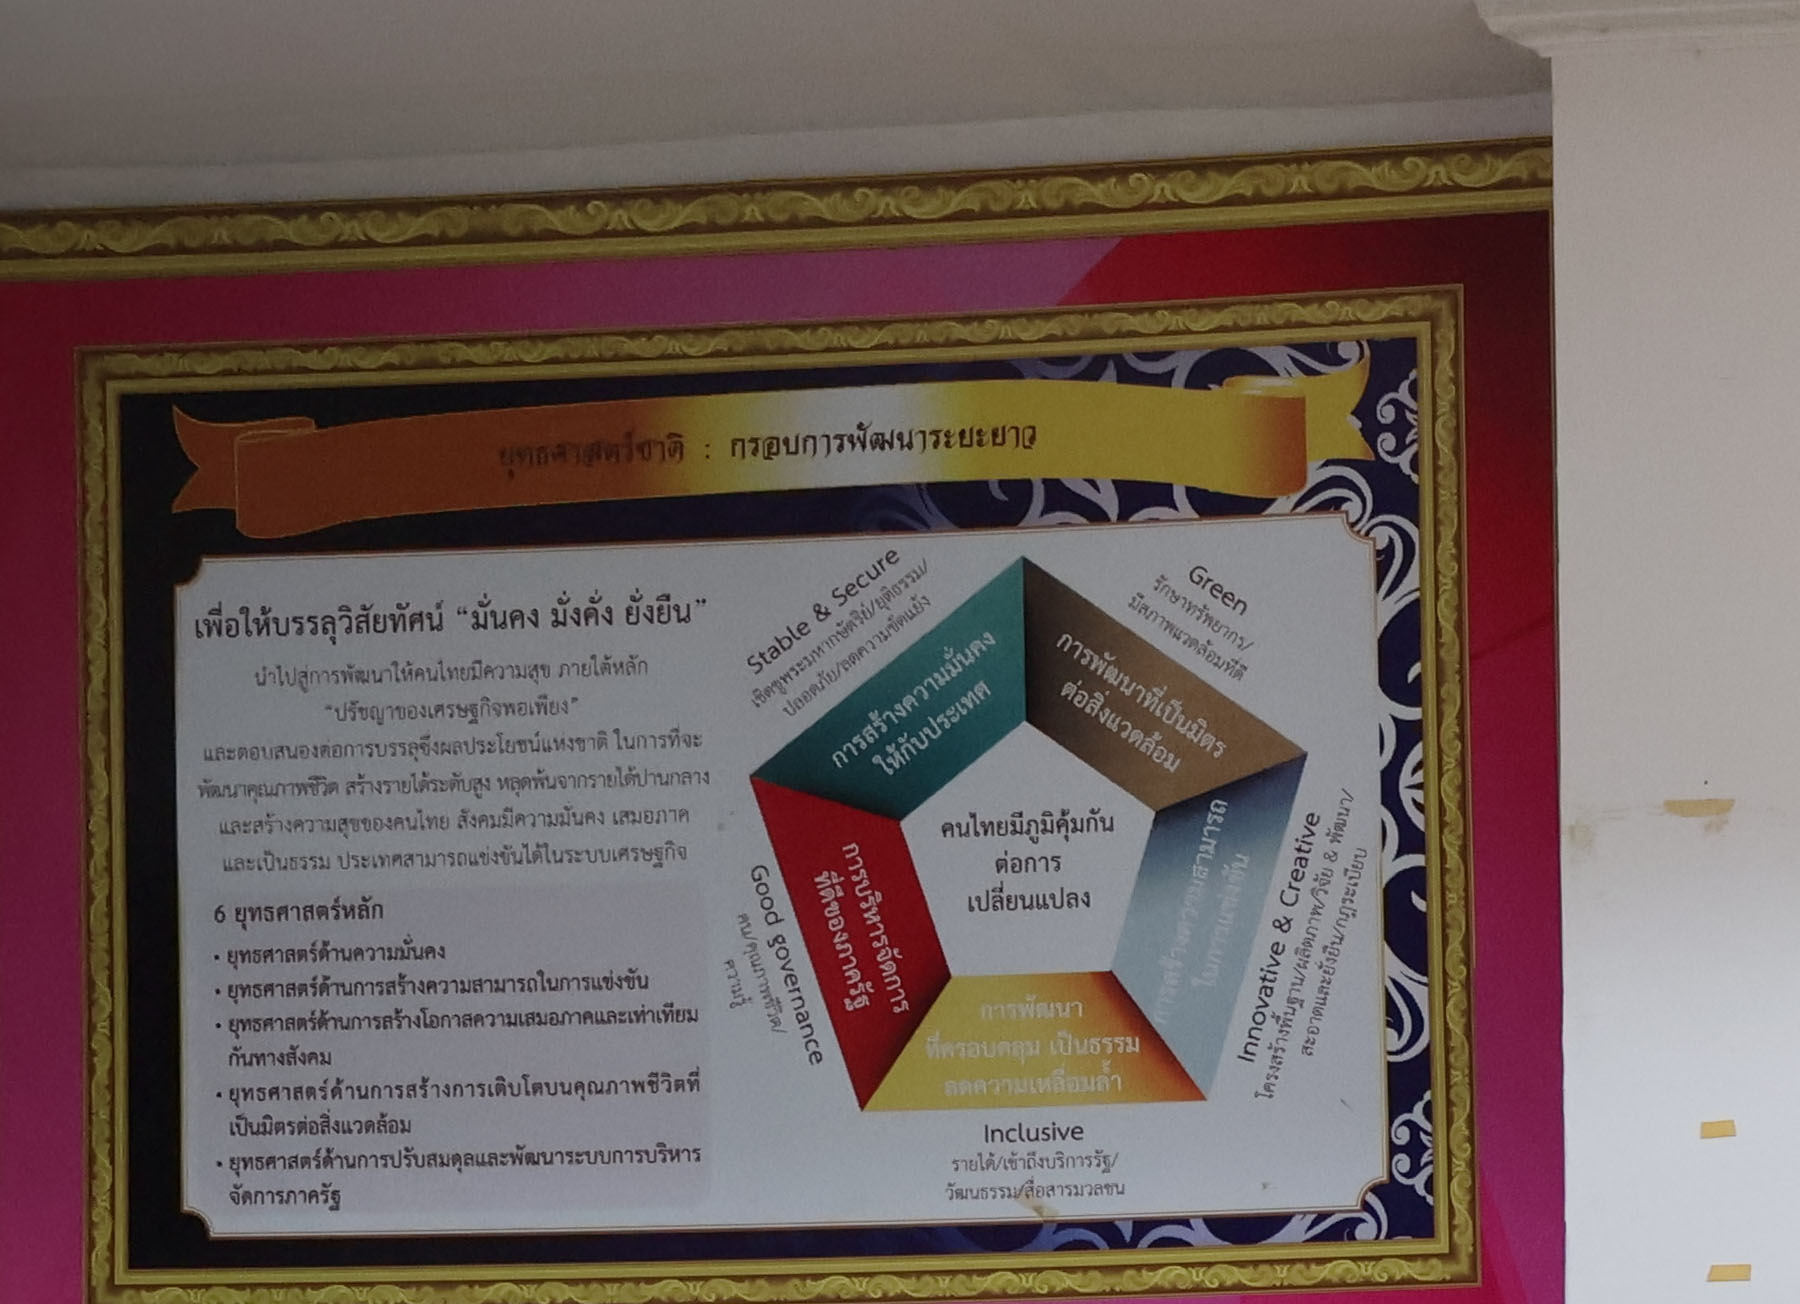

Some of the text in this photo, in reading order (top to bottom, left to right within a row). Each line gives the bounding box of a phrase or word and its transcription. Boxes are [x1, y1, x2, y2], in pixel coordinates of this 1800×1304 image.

[731, 420, 1038, 461] กรอบการพัฒนาระยะยาว
[1188, 565, 1249, 617] Green
[194, 600, 444, 645] เพื่อให้บรรลุวิสัยทัศน์
[550, 592, 614, 629] มั่งคั่ง
[747, 549, 901, 676] Stable & Secure
[1056, 632, 1227, 760] การพัฒนาที่เป็นมิตร
[1060, 679, 1182, 775] ต่อสิ่งแวดล้อม
[941, 809, 1115, 846] คนไทยมีภูมิคุ้มกัน
[995, 851, 1062, 875] ต่อการ
[212, 897, 384, 931] 6 ยุทธศาสตร์หลัก
[968, 882, 1092, 914] เปลี่ยนแปลง
[227, 933, 446, 969] ยุทธศาสตร์ด้านความมั่นคง
[1238, 811, 1321, 1063] Innovative & Creative
[750, 864, 824, 1068] Good governance
[229, 1046, 332, 1069] กันทางสังคม
[230, 1109, 412, 1138] เป็นมิตรต่อสิ่งแวดล้อม
[984, 1121, 1085, 1145] Inclusive
[230, 1183, 343, 1212] จัดการภาครัฐ
